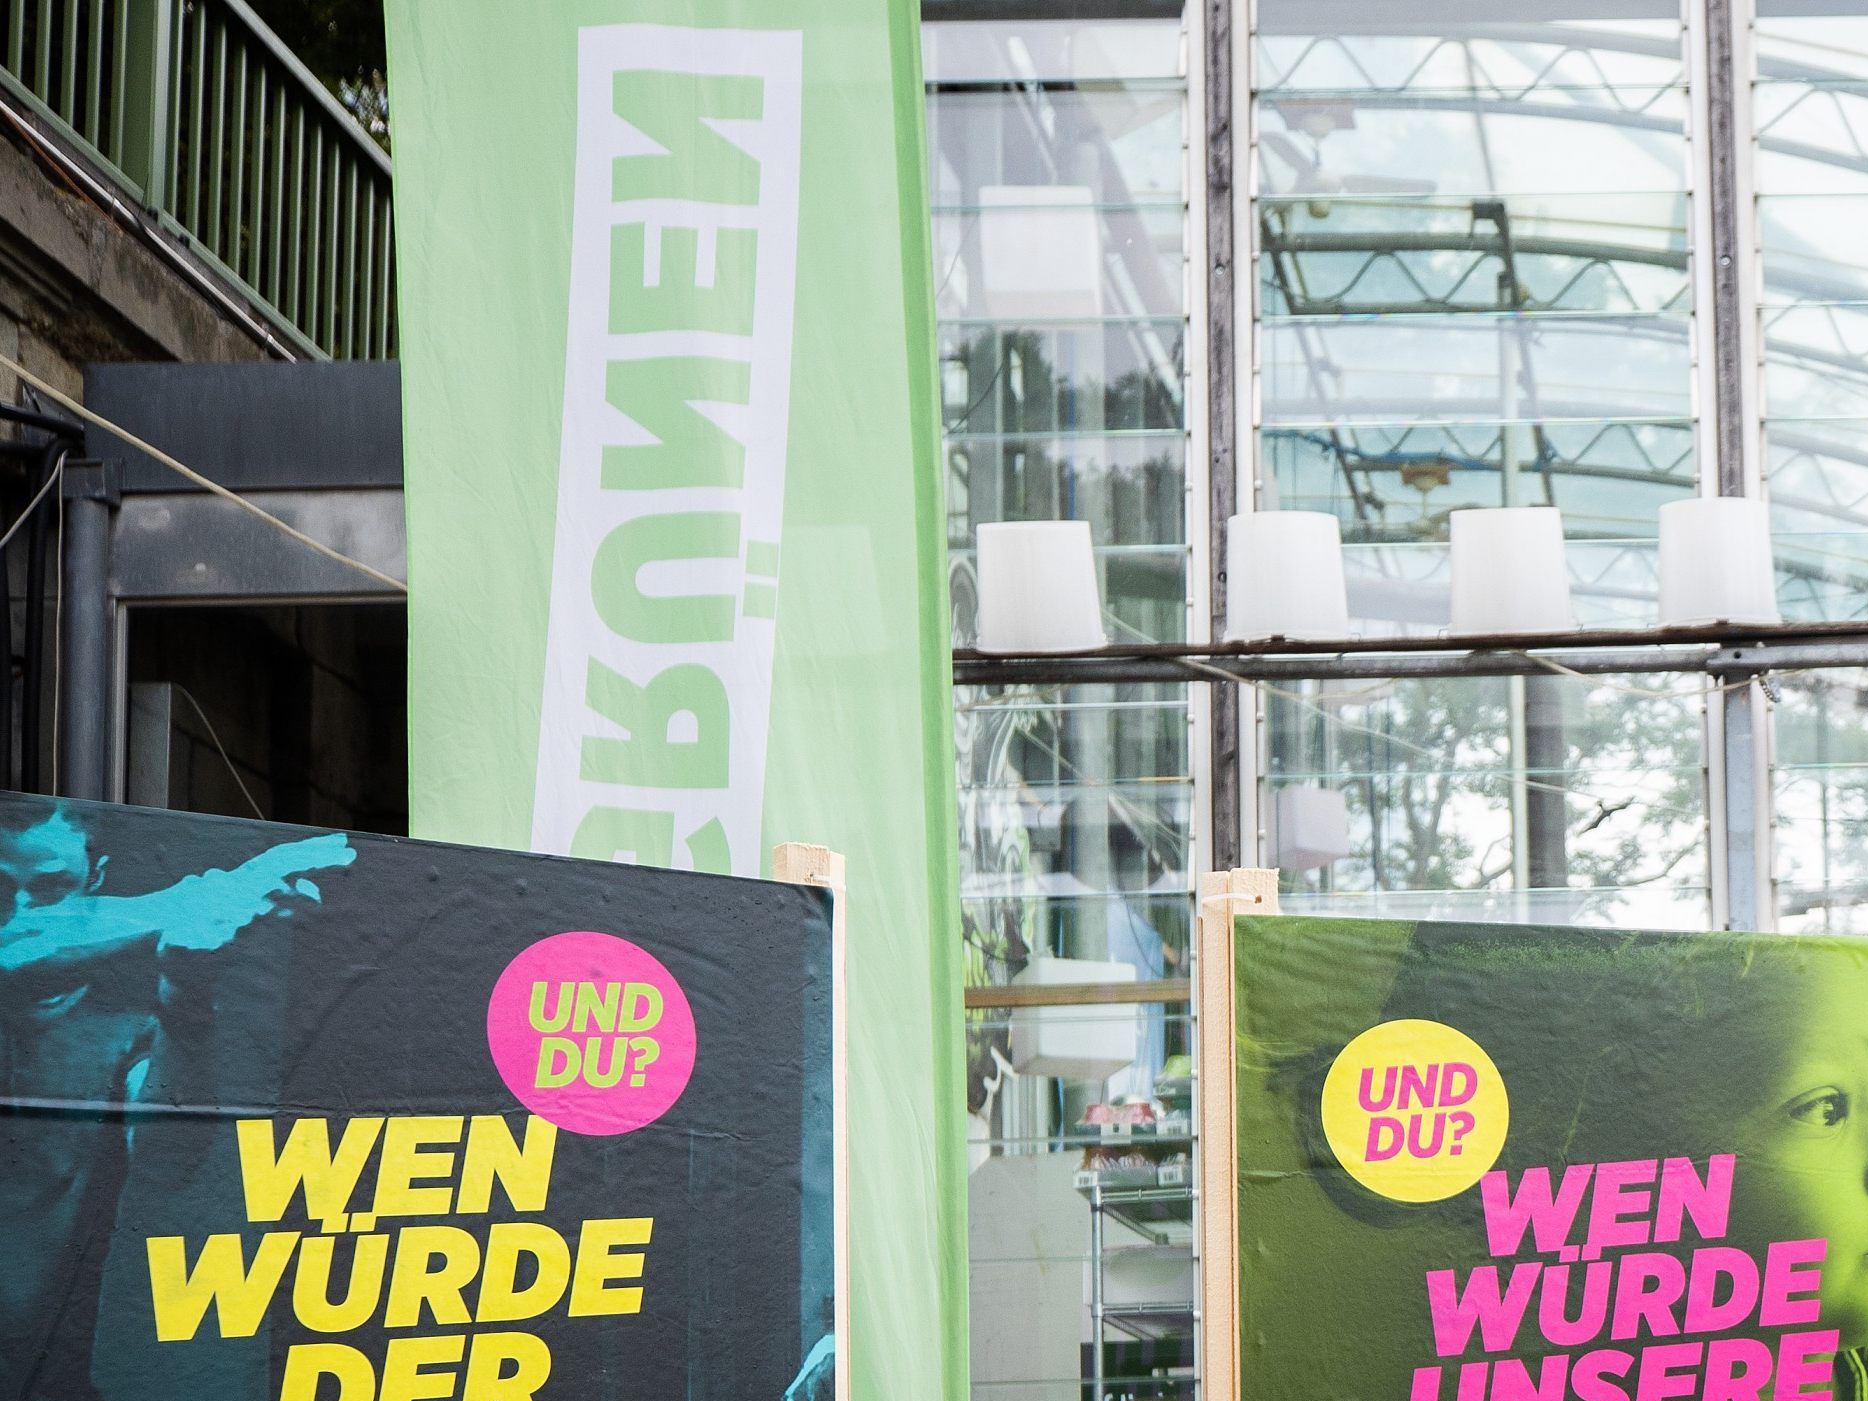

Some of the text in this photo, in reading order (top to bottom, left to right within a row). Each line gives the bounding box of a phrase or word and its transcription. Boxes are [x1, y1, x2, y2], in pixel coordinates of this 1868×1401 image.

[531, 982, 662, 1033] UND
[536, 1038, 659, 1088] DU?
[1359, 1063, 1477, 1112] UND
[237, 1115, 557, 1222] WEN
[1365, 1112, 1475, 1162] DU?
[1480, 1153, 1736, 1257] WEN
[147, 1212, 652, 1341] WÜRDE
[1426, 1238, 1828, 1357] WÜRDE
